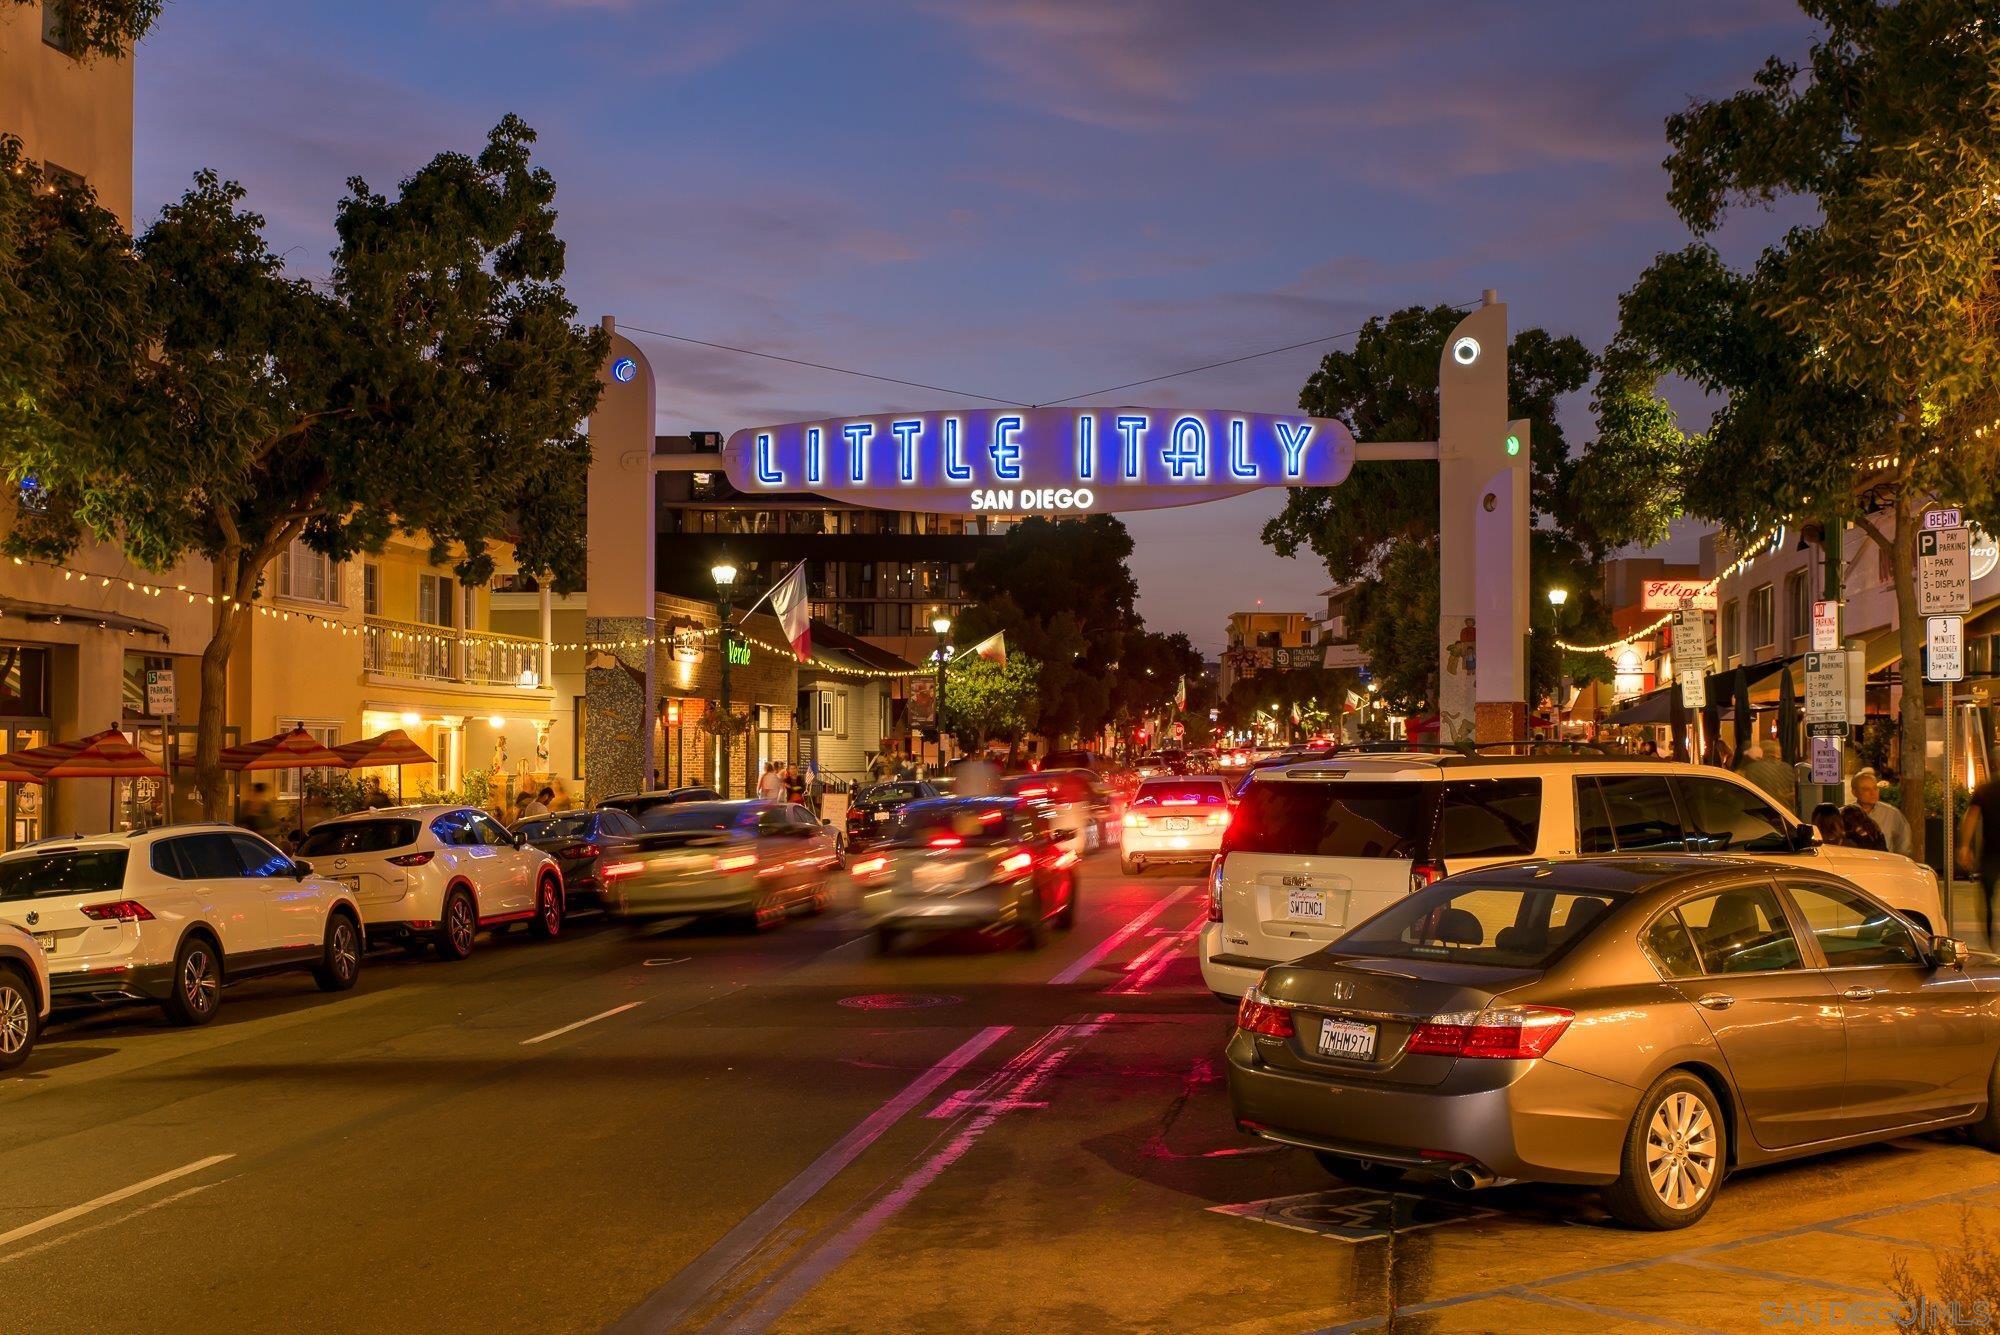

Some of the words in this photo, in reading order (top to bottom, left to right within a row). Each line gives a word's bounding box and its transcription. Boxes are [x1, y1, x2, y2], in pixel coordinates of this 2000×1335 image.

[758, 417, 1020, 482] LITTLE
[1081, 416, 1312, 477] ITALY
[970, 489, 1014, 509] SAN
[1020, 488, 1094, 509] DIEGO
[1930, 512, 1957, 526] BEGIN
[1946, 533, 1958, 541] PAY
[1922, 535, 1933, 553] P
[1939, 542, 1966, 552] PARKING
[1935, 558, 1954, 566] PARK
[1935, 569, 1948, 577] PAY
[1935, 579, 1965, 588] DISPLAY
[1815, 604, 1824, 616] NO
[1674, 614, 1681, 624] P
[1815, 617, 1835, 627] PARKING
[1934, 634, 1956, 643] MINUTE
[728, 638, 751, 665] Verde
[1808, 657, 1818, 670] P
[149, 672, 157, 683] 15
[150, 686, 172, 695] PARKING
[1282, 876, 1314, 888] GMC
[1290, 900, 1323, 915] SWTINC1
[1323, 1030, 1371, 1053] 7MHM971
